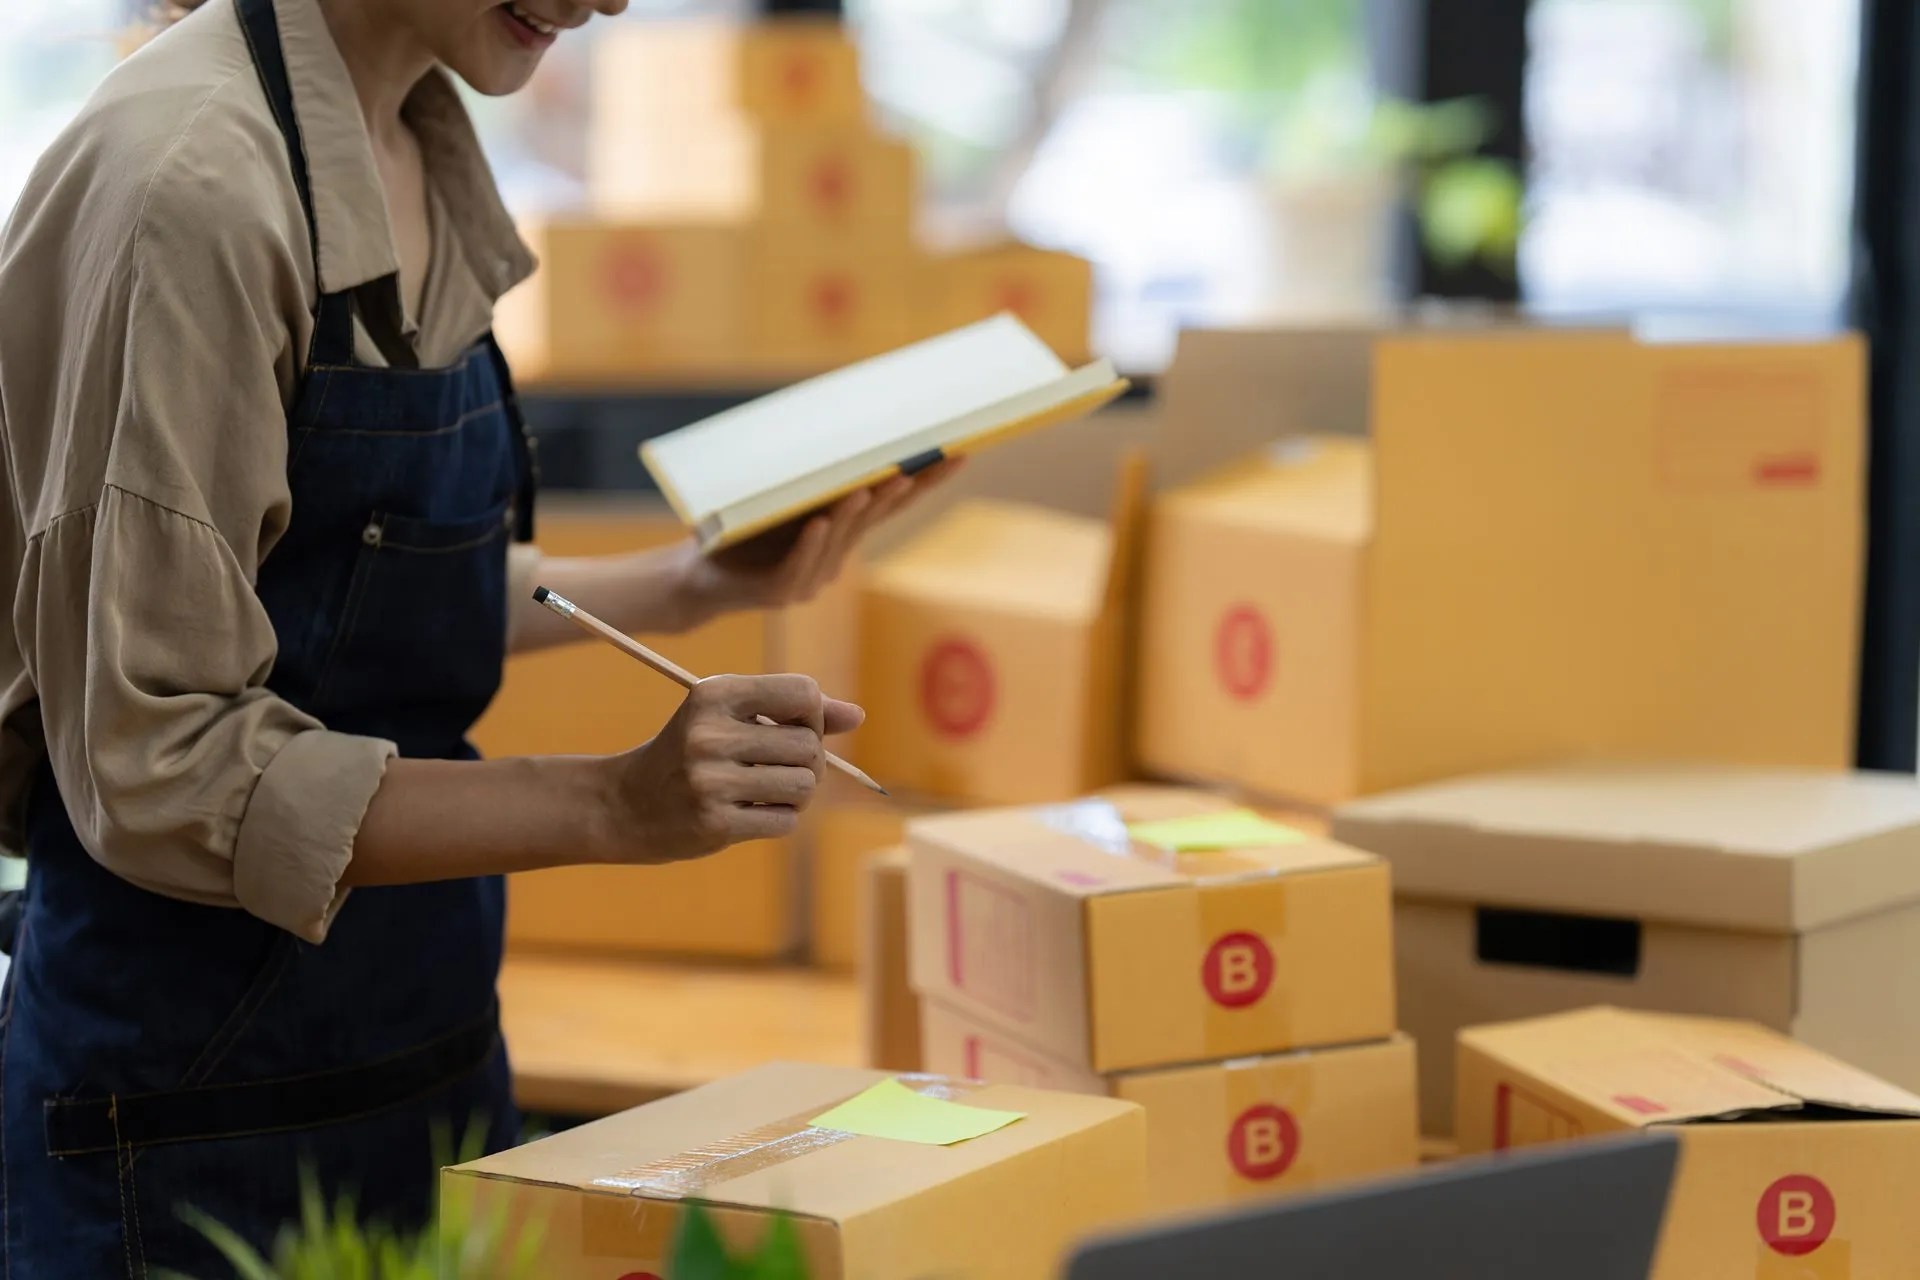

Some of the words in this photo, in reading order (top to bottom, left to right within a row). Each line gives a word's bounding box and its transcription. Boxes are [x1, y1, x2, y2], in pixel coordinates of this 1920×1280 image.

[1220, 946, 1257, 993] B
[1245, 1119, 1282, 1166] B
[1777, 1191, 1816, 1237] B
